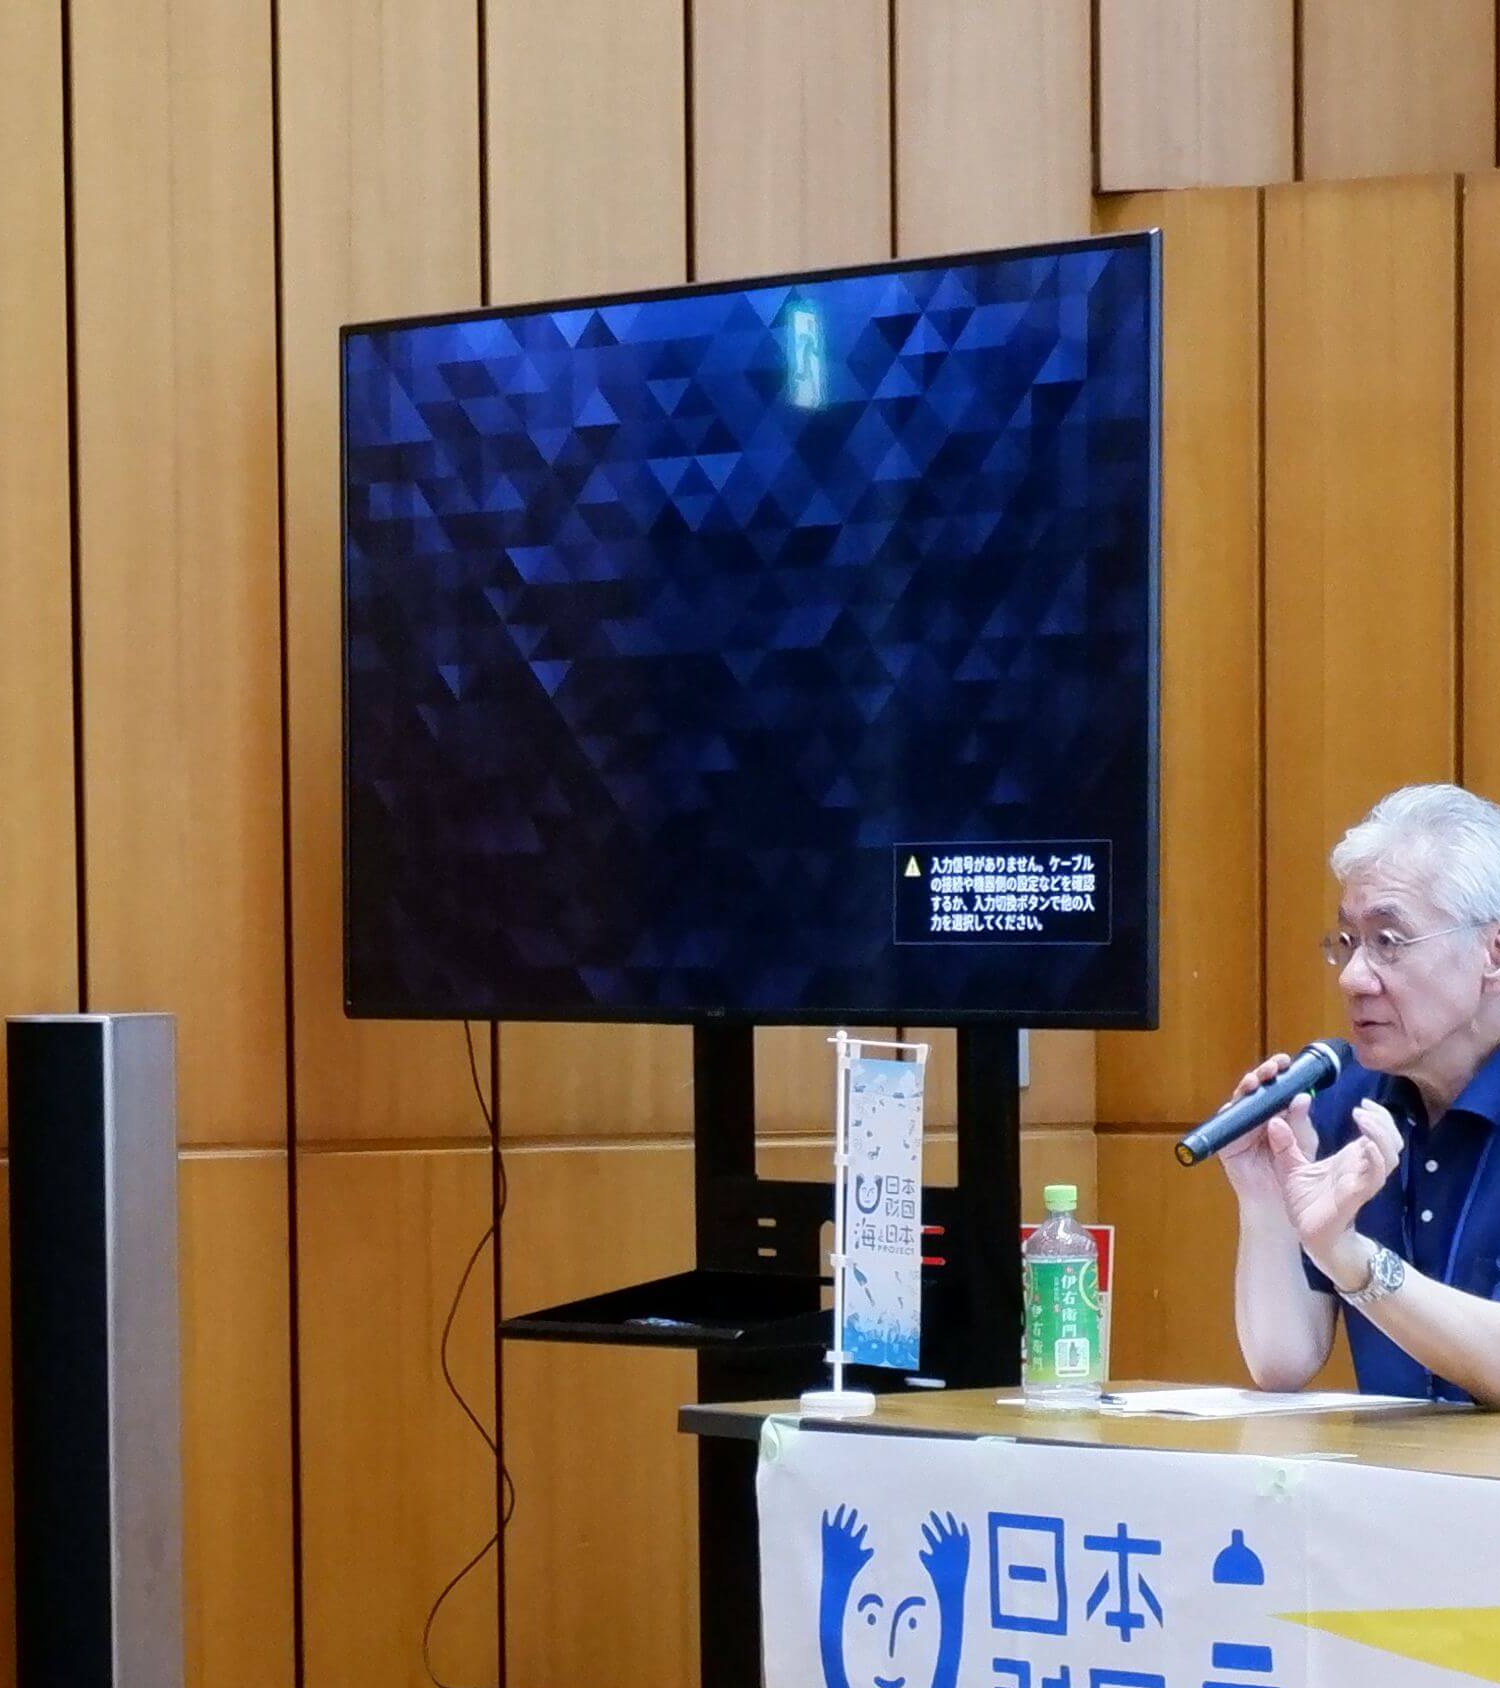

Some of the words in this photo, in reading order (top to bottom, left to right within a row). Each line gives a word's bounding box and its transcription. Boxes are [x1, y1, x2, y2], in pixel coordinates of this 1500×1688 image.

[930, 914, 1044, 932] 力を選択してください。
[885, 1175, 916, 1196] 日本
[854, 1217, 915, 1251] 海と日本
[987, 1511, 1164, 1643] 日本
